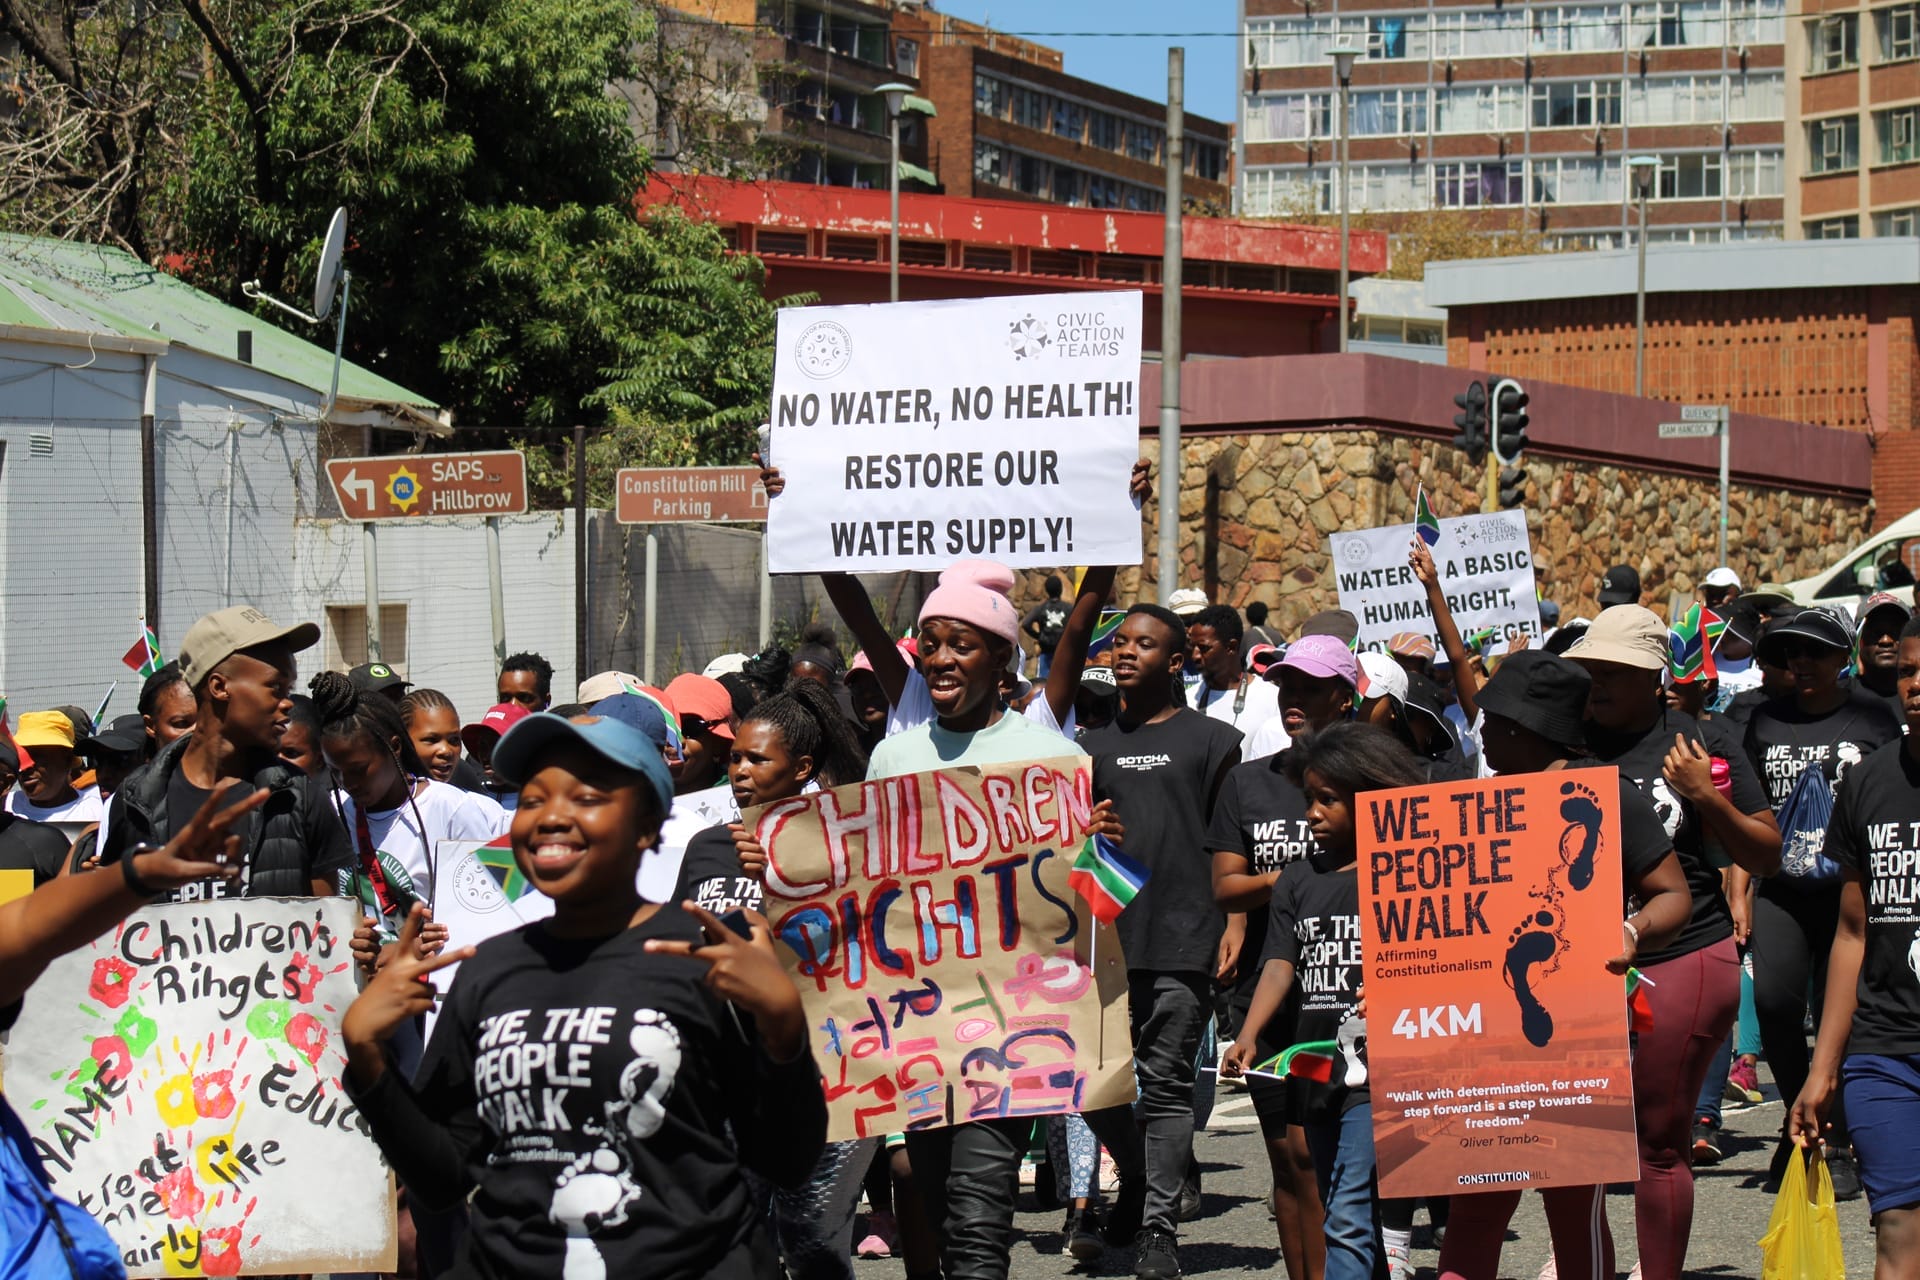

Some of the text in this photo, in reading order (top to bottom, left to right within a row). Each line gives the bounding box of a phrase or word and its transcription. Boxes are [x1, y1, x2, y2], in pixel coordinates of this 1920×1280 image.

[1057, 313, 1105, 328] CIVIC
[1057, 327, 1125, 343] ACTION
[1057, 342, 1119, 357] TEAMS
[778, 381, 1133, 429] NO WATER, NO HEALTH!
[432, 460, 484, 483] SAPS
[845, 450, 1060, 490] RESTORE OUR
[624, 474, 746, 495] Constitution Hill
[432, 490, 511, 512] Hillbrow
[652, 498, 712, 518] Parking
[1479, 517, 1506, 528] CIVIC
[1481, 524, 1518, 537] ACTION
[831, 517, 1073, 557] WATER SUPPLY!
[1482, 533, 1517, 545] TEAMS
[1340, 550, 1529, 592] WATER A BASIC
[1447, 587, 1516, 614] RIGHT,
[1116, 754, 1171, 766] GOTCHA
[1766, 745, 1830, 760] WE, THE
[1370, 787, 1527, 844] WE, THE
[756, 764, 1093, 900] CHILDREN
[1253, 820, 1289, 842] WE,
[1867, 822, 1903, 851] WE,
[1370, 838, 1513, 895] PEOPLE
[697, 876, 763, 900] WE, TH
[1293, 914, 1361, 942] WE, TH
[1372, 890, 1491, 944] WALK
[121, 908, 331, 971] Children's
[1375, 948, 1437, 963] Affirming
[1296, 966, 1350, 993] WALK
[1375, 959, 1493, 979] Constitutionalism
[479, 1006, 617, 1050] WE, THE
[1391, 1002, 1483, 1040] 4KM
[475, 1042, 592, 1097] PEOPLE
[1426, 1087, 1454, 1100] with
[1457, 1080, 1549, 1098] determination,
[1551, 1078, 1570, 1090] for
[1573, 1077, 1609, 1089] every
[476, 1087, 572, 1136] WALK
[1404, 1094, 1593, 1119] step forward is a step towards
[1460, 1133, 1540, 1149] Oliver Tambo
[78, 1132, 183, 1217] treat
[123, 1223, 202, 1269] airly
